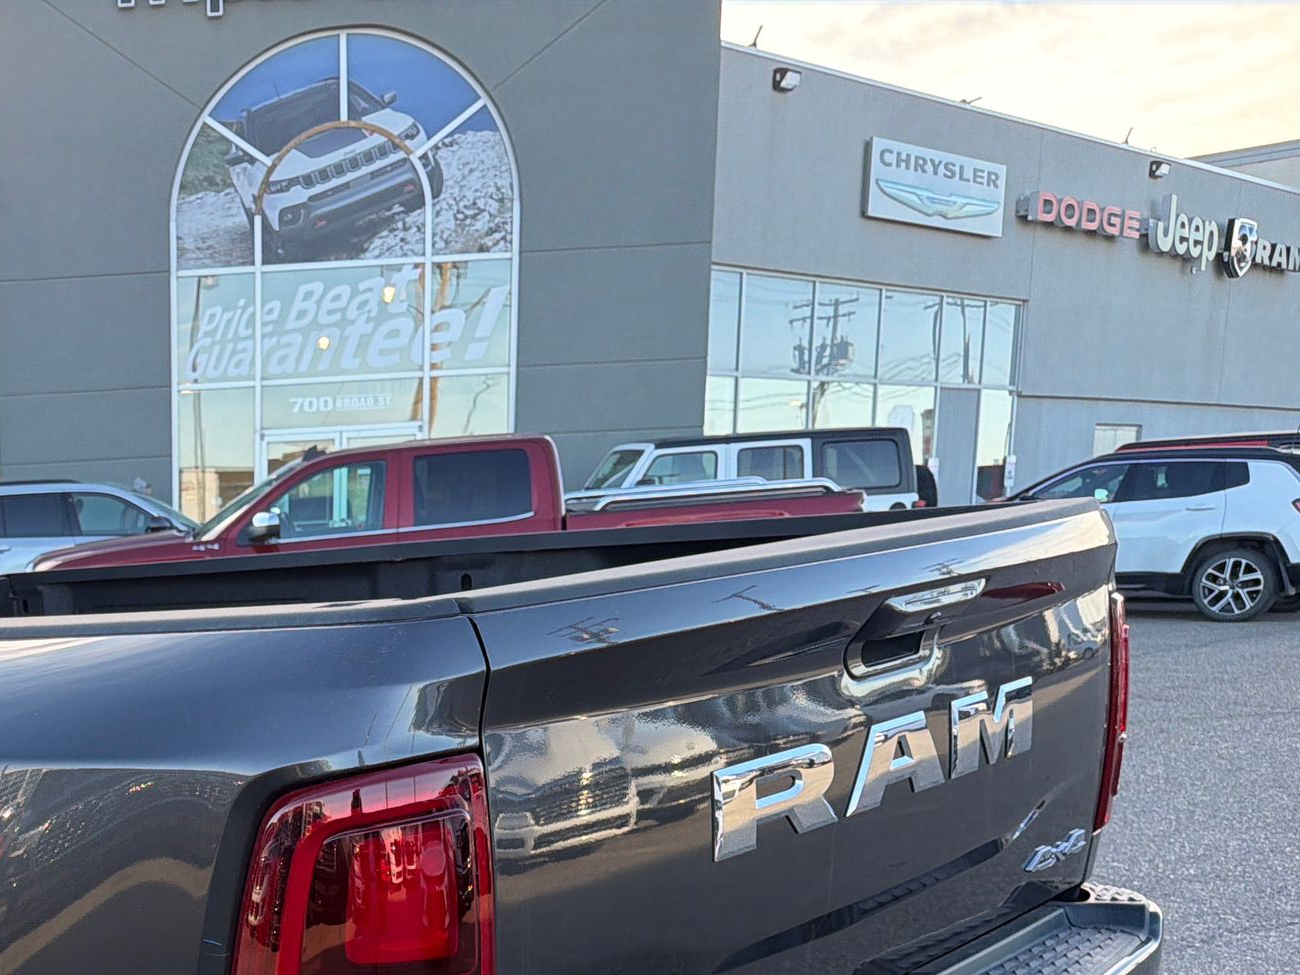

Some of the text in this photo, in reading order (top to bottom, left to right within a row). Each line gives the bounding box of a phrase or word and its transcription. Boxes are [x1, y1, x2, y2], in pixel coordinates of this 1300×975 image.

[879, 148, 1000, 189] CHRYSLER
[1037, 191, 1141, 240] DODGE
[1155, 193, 1219, 272] Jeep
[183, 284, 512, 379] Guarantee!
[198, 266, 423, 341] Price Beat
[289, 396, 334, 413] 700
[712, 675, 1033, 863] RAM
